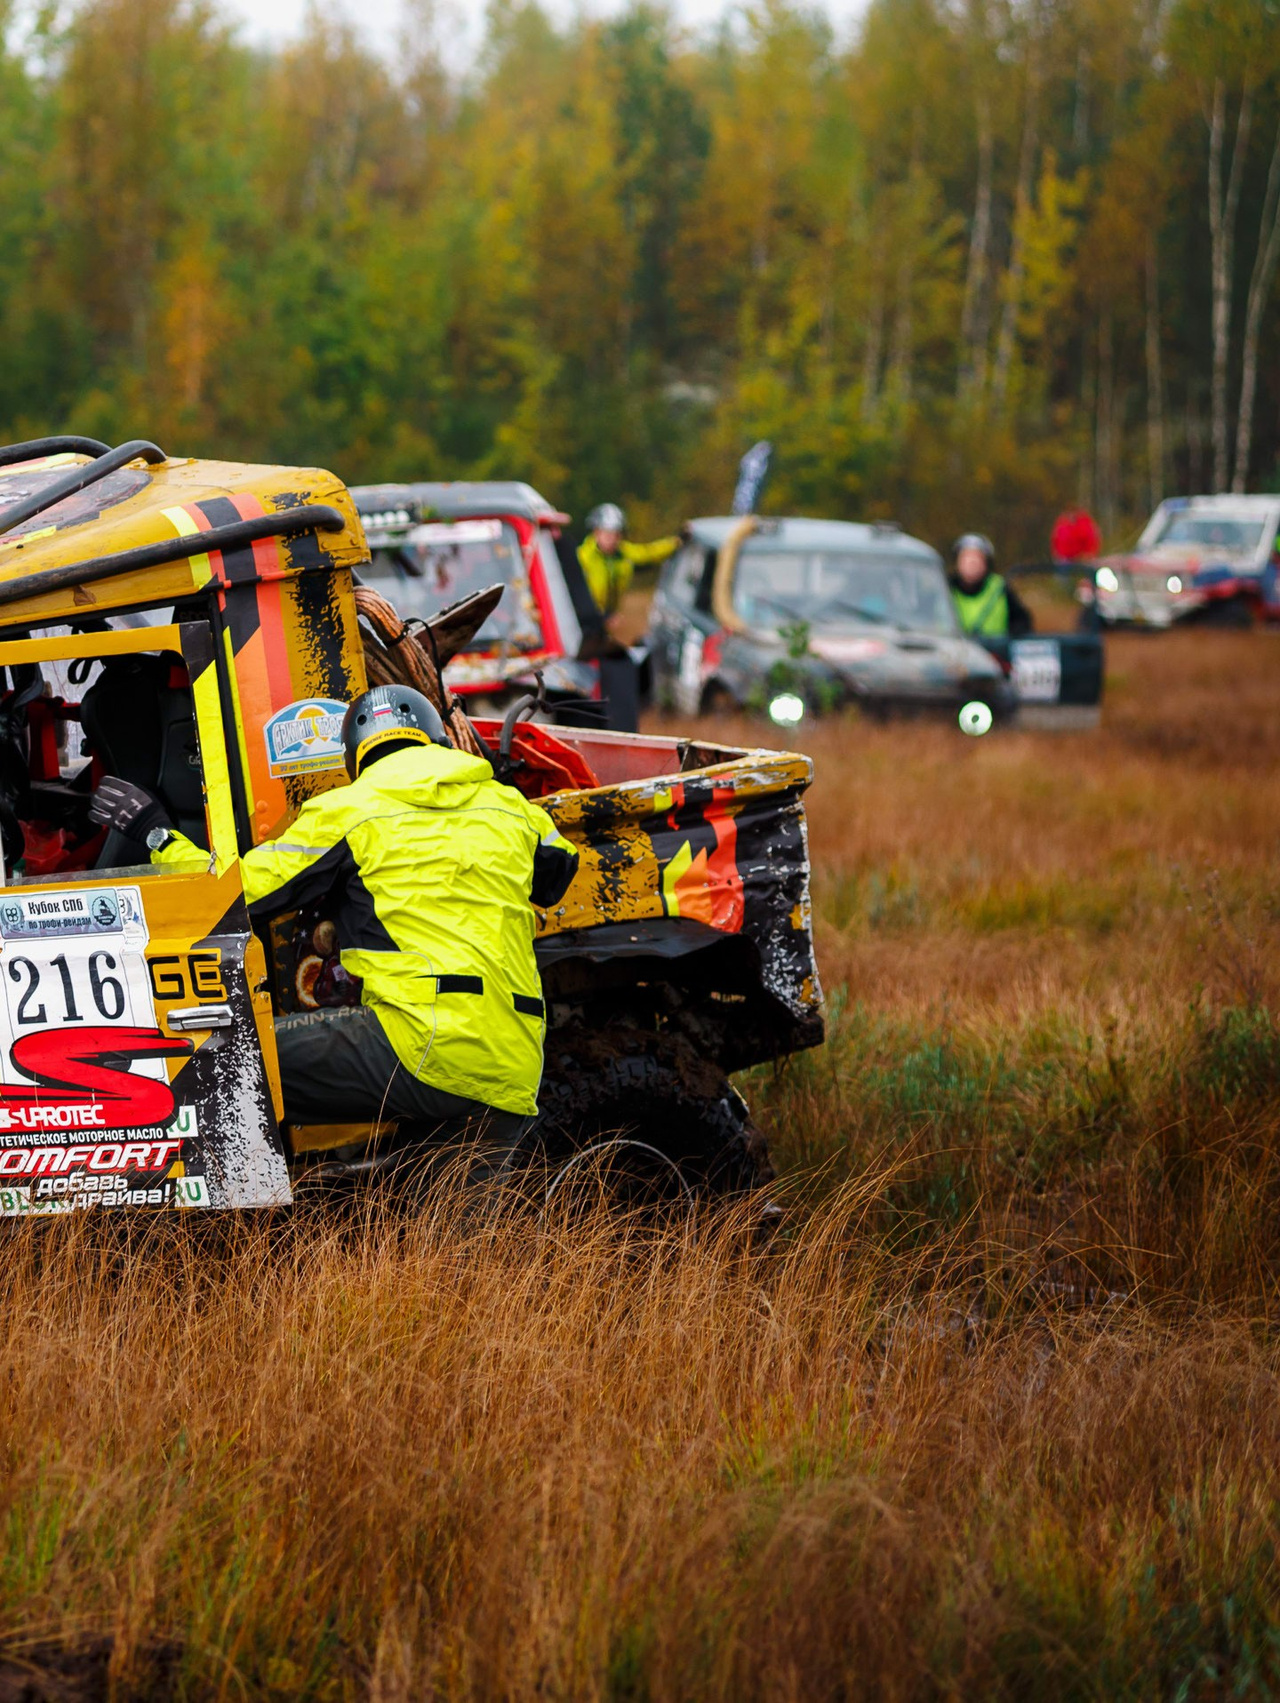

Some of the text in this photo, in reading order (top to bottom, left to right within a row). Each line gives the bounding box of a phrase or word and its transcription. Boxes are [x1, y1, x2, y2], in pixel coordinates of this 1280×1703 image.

[403, 730, 422, 738] TEAM
[28, 898, 84, 916] Кубок СПб
[8, 950, 126, 1025] 216
[69, 1129, 126, 1145] МОТОРНОЕ
[127, 1127, 164, 1141] МАСЛО
[37, 1171, 129, 1197] добавь
